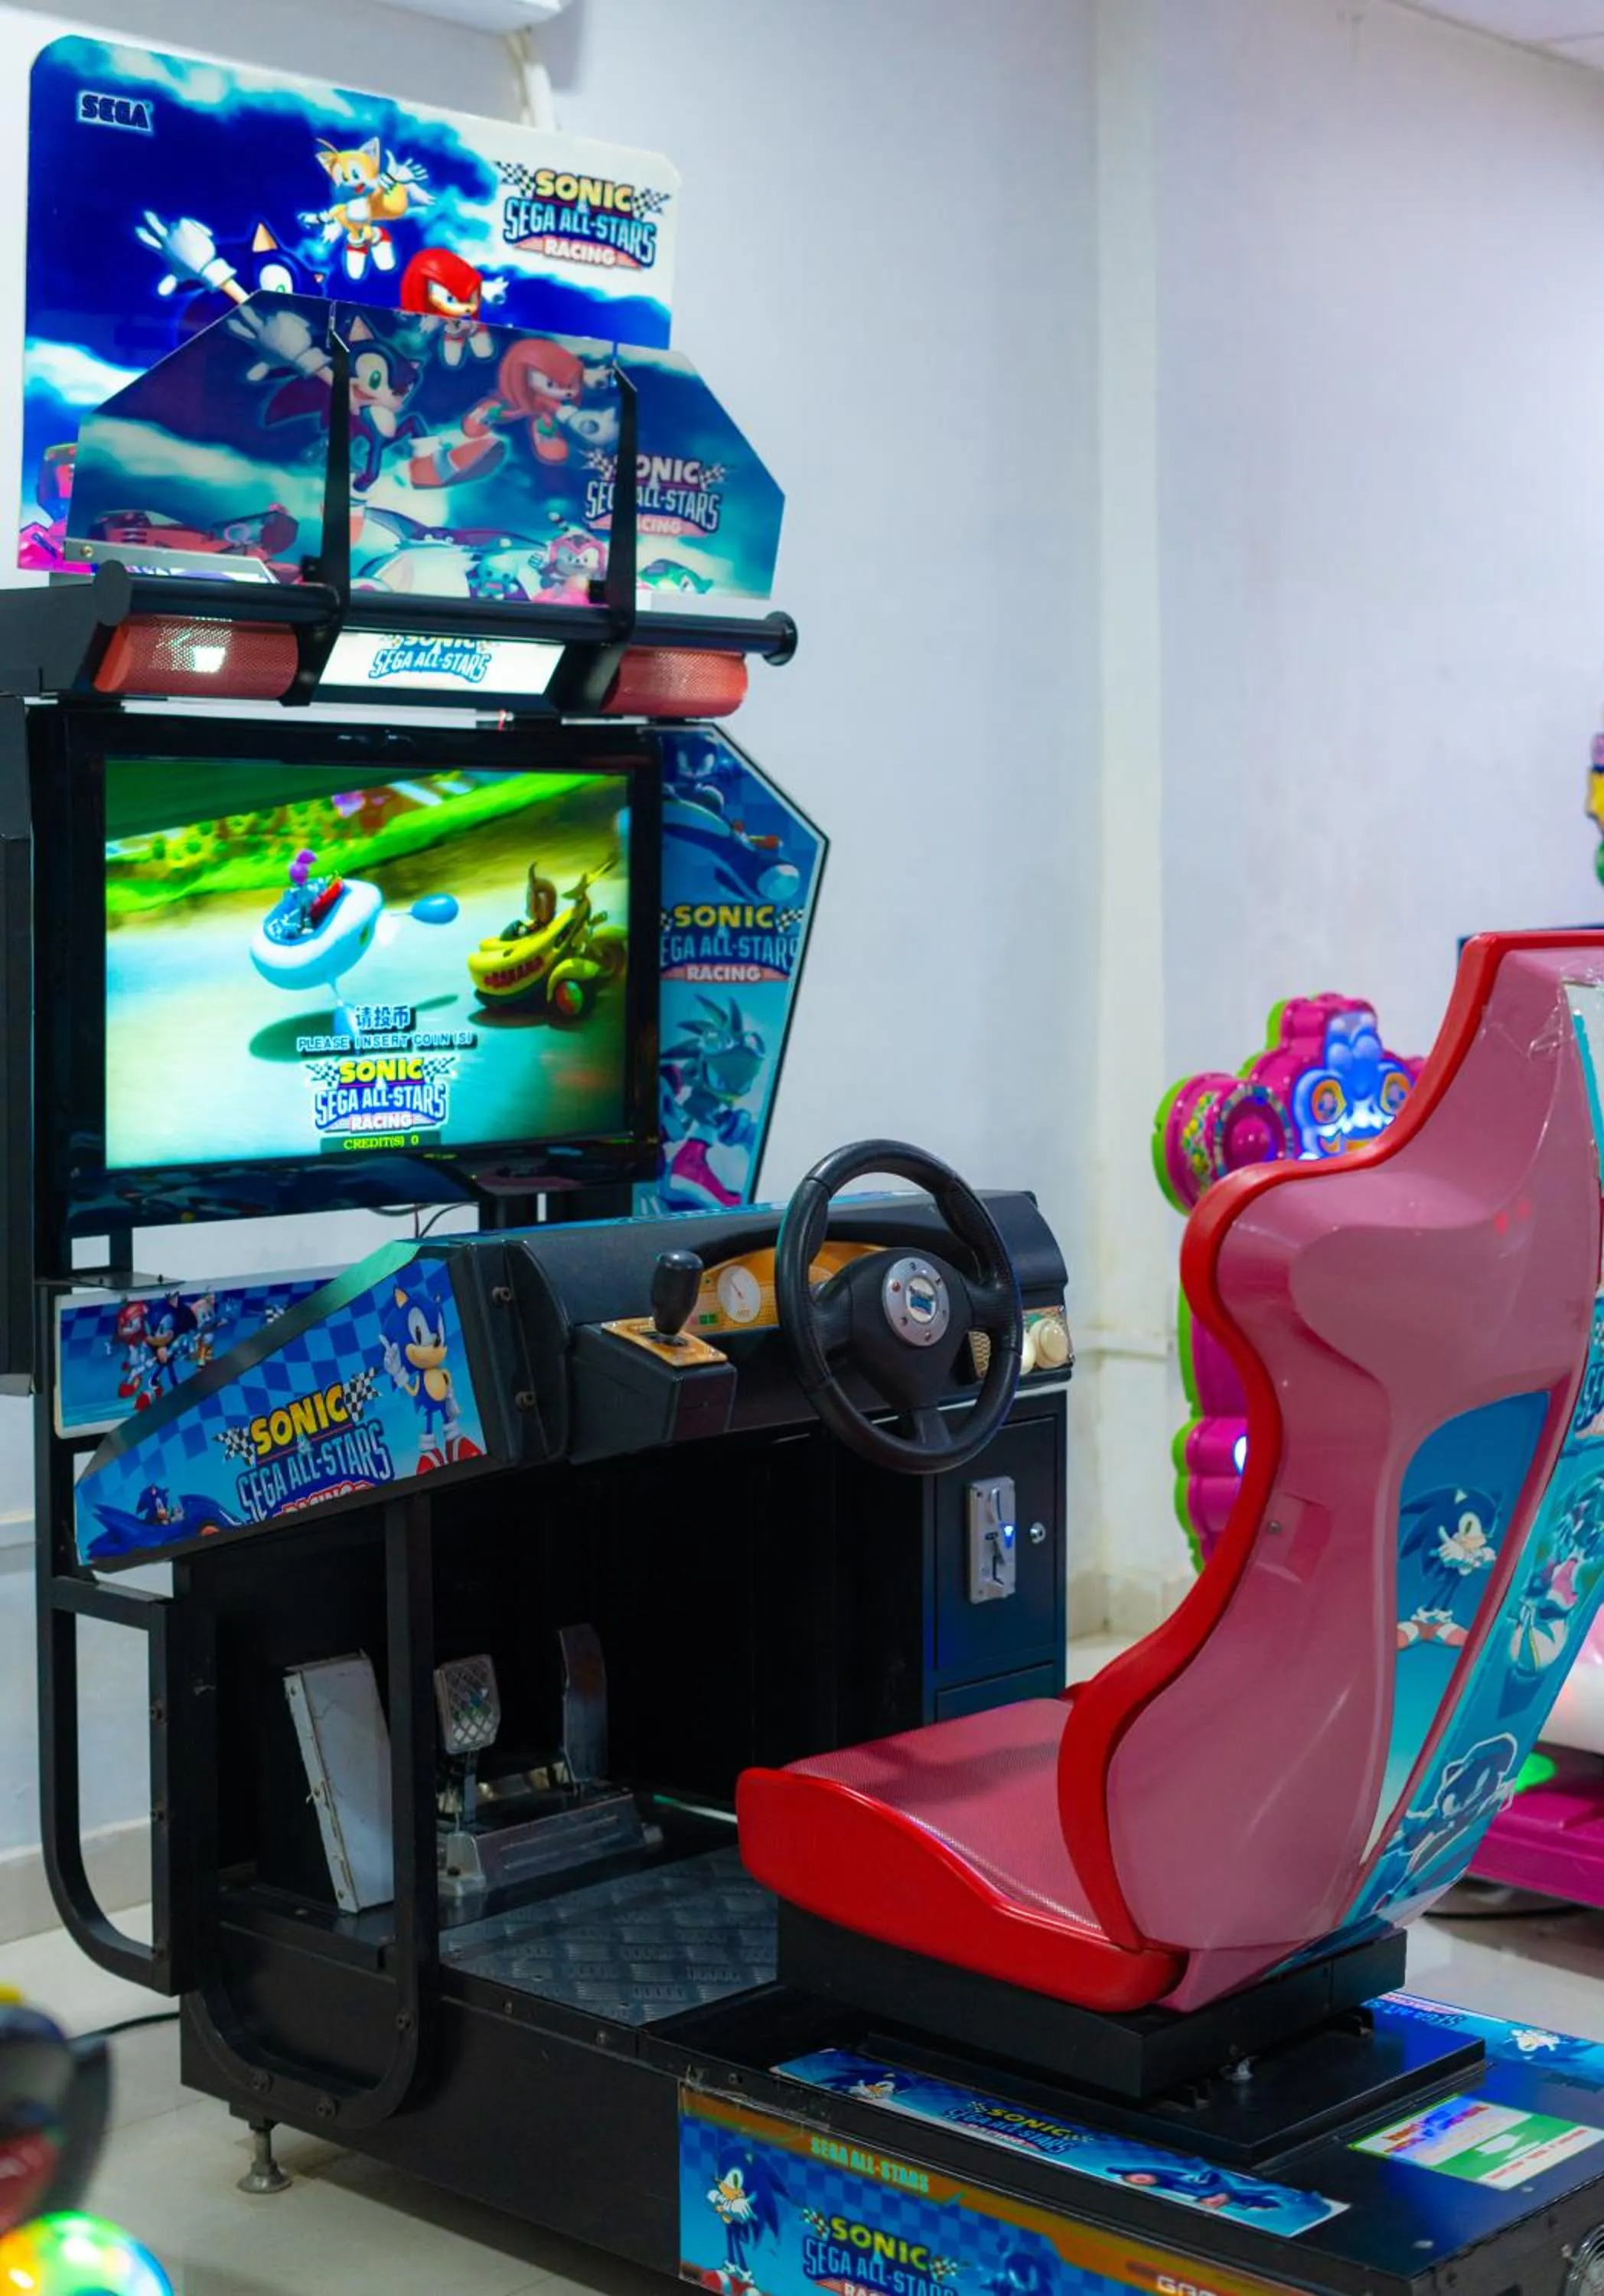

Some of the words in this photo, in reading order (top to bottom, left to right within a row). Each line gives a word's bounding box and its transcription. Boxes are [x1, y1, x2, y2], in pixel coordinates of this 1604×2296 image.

[82, 94, 149, 129] SEGA
[535, 168, 634, 212] SONIC
[504, 197, 556, 243] SEGA
[559, 209, 657, 265] ALL-STARS
[544, 237, 617, 266] RACING
[615, 454, 702, 484] ONIC
[370, 649, 412, 678] SEGA
[415, 651, 492, 683] ALL-STARS
[673, 905, 774, 929] SONIC
[660, 934, 695, 968] EGA
[687, 965, 761, 982] RACING
[355, 1005, 412, 1030] 请投币
[297, 1037, 350, 1052] PLEASE
[354, 1034, 409, 1050] INSERT
[339, 1058, 425, 1084] SONIC
[315, 1088, 359, 1127] SEGA
[362, 1084, 446, 1120] ALL-STARS
[350, 1113, 413, 1132] RACING
[343, 1134, 405, 1150] CREDIT(S)
[250, 1384, 348, 1456] SONIC
[238, 1462, 288, 1522] SEGA
[288, 1421, 391, 1491] ALL-STARS
[987, 2108, 1071, 2136] SONIC
[811, 2136, 848, 2167] SEGA
[850, 2150, 929, 2193] ALL-STARS
[806, 2239, 852, 2276] SEGA
[831, 2216, 928, 2272] SONIC
